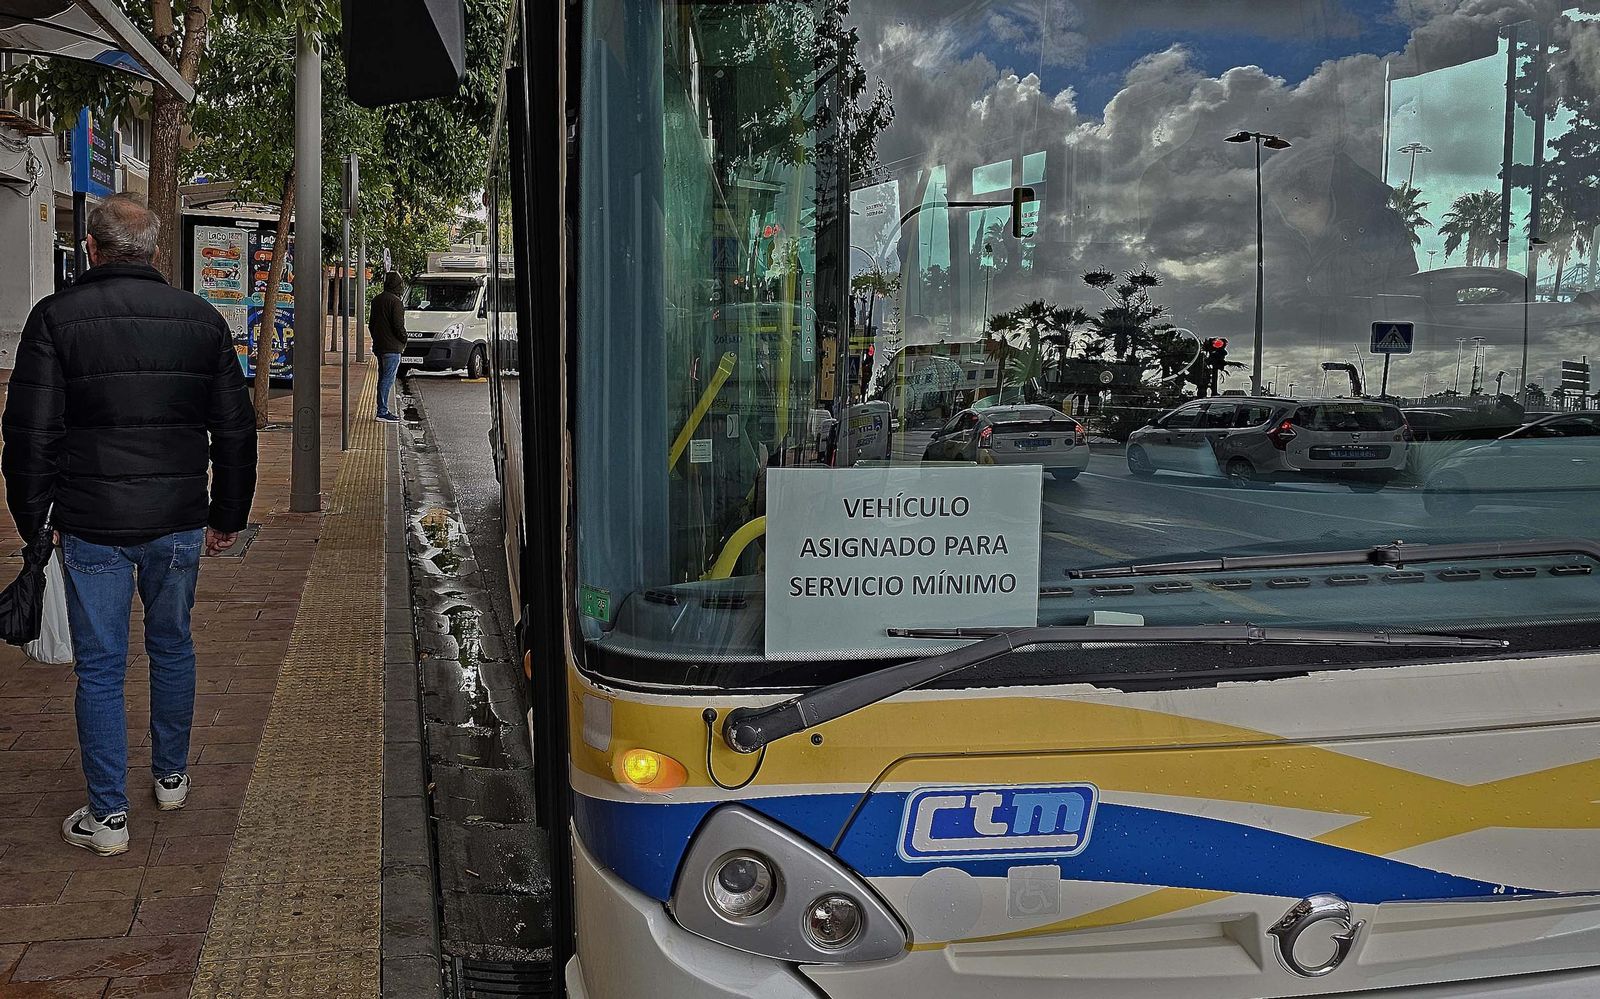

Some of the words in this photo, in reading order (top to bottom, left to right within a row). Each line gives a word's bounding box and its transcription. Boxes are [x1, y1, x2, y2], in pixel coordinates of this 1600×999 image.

[804, 279, 813, 355] EMPUJAR
[843, 492, 970, 518] VEHÍCULO
[799, 536, 936, 558] ASIGNADO
[944, 534, 1009, 556] PARA
[789, 575, 904, 597] SERVICIO
[912, 569, 1017, 595] MÍNIMO
[111, 815, 125, 824] NIKE
